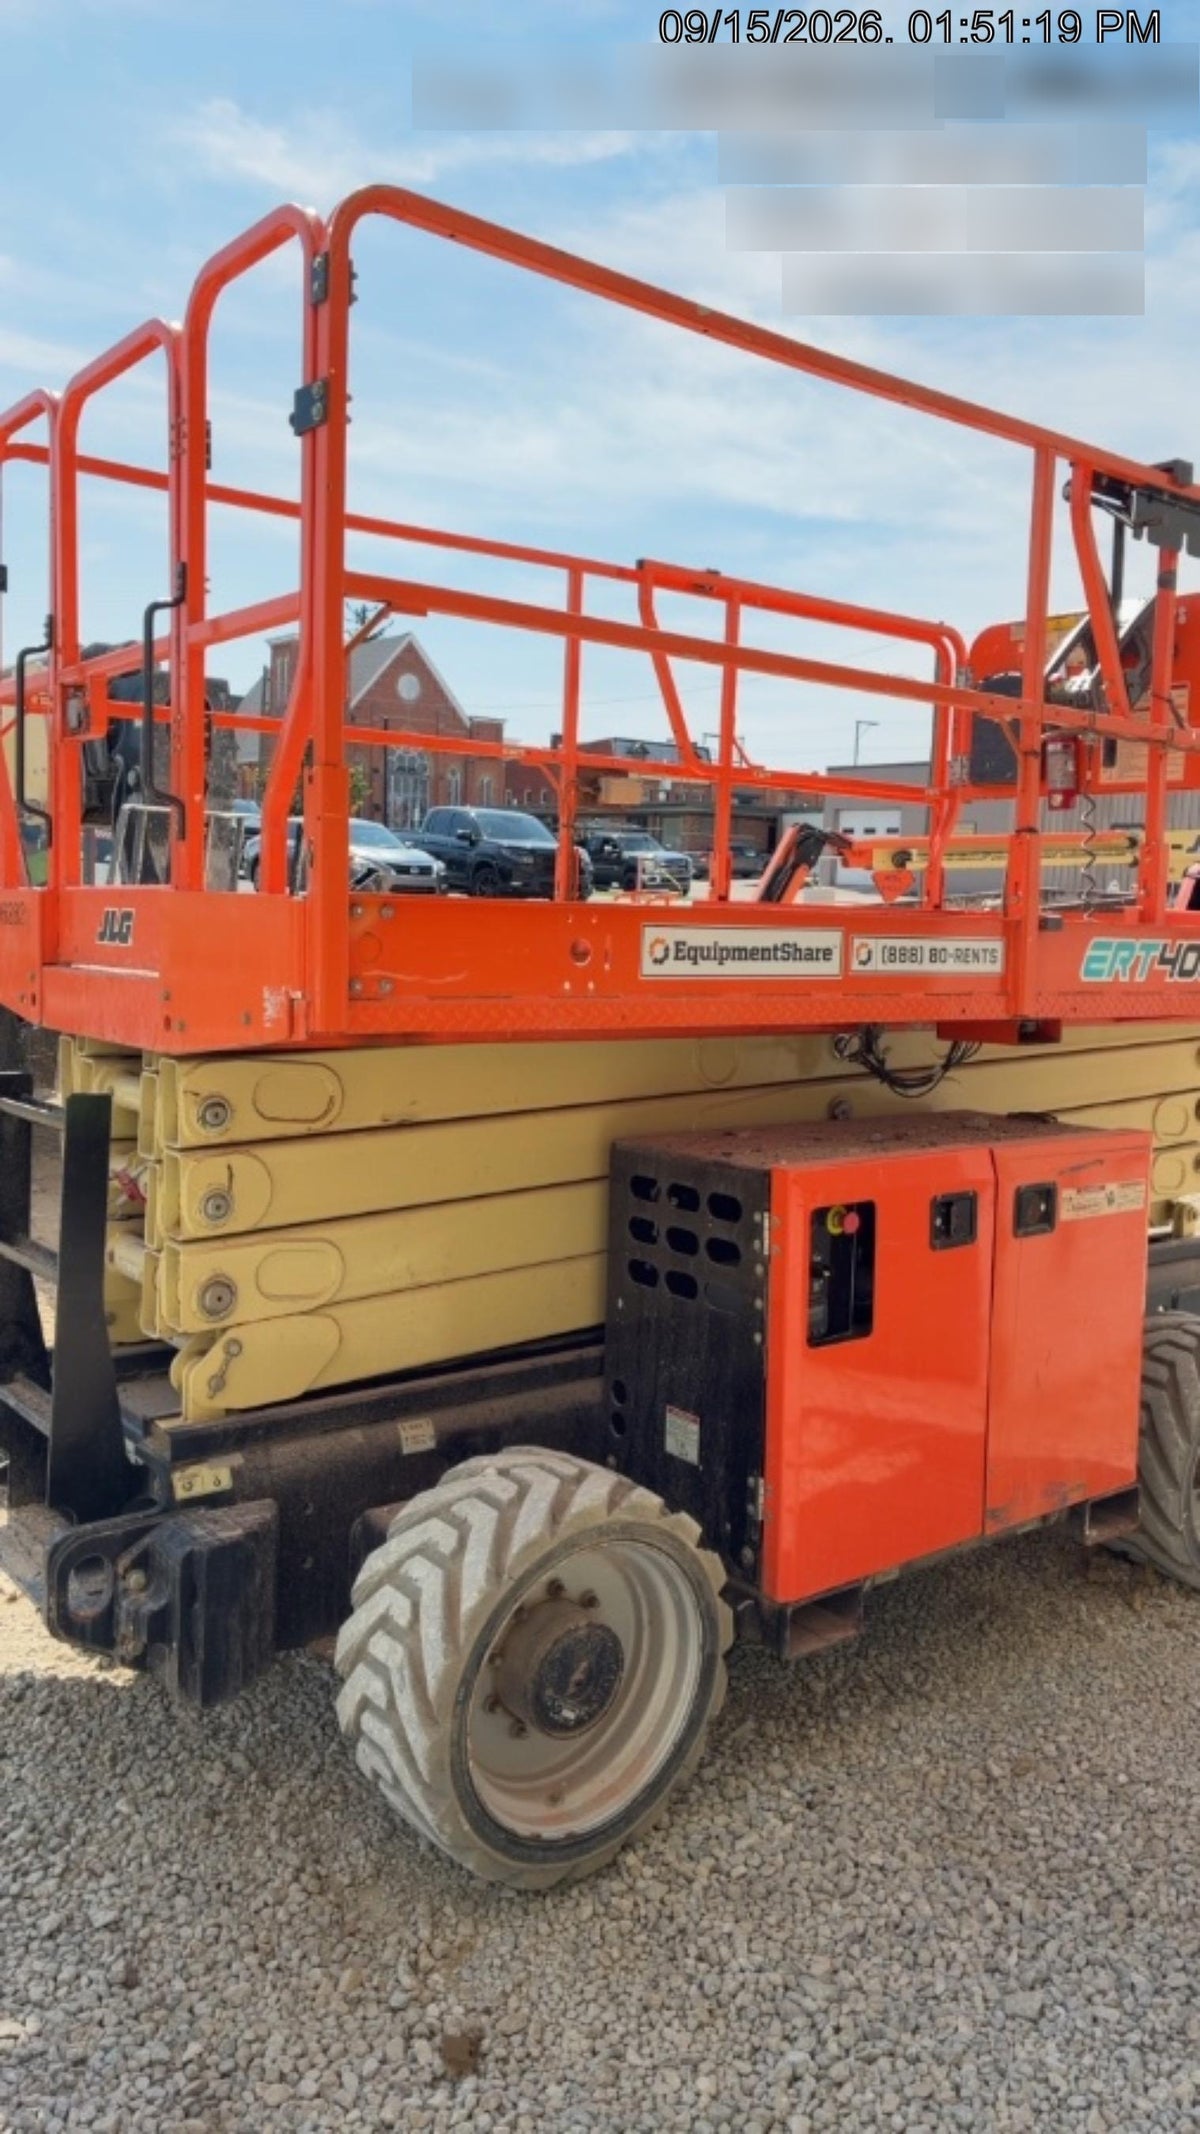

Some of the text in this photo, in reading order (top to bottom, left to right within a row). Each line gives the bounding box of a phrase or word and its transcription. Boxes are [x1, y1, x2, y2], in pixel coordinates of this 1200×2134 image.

[97, 909, 134, 945] JLG
[673, 940, 833, 966] EquipmentShare
[1082, 938, 1200, 980] ERT40
